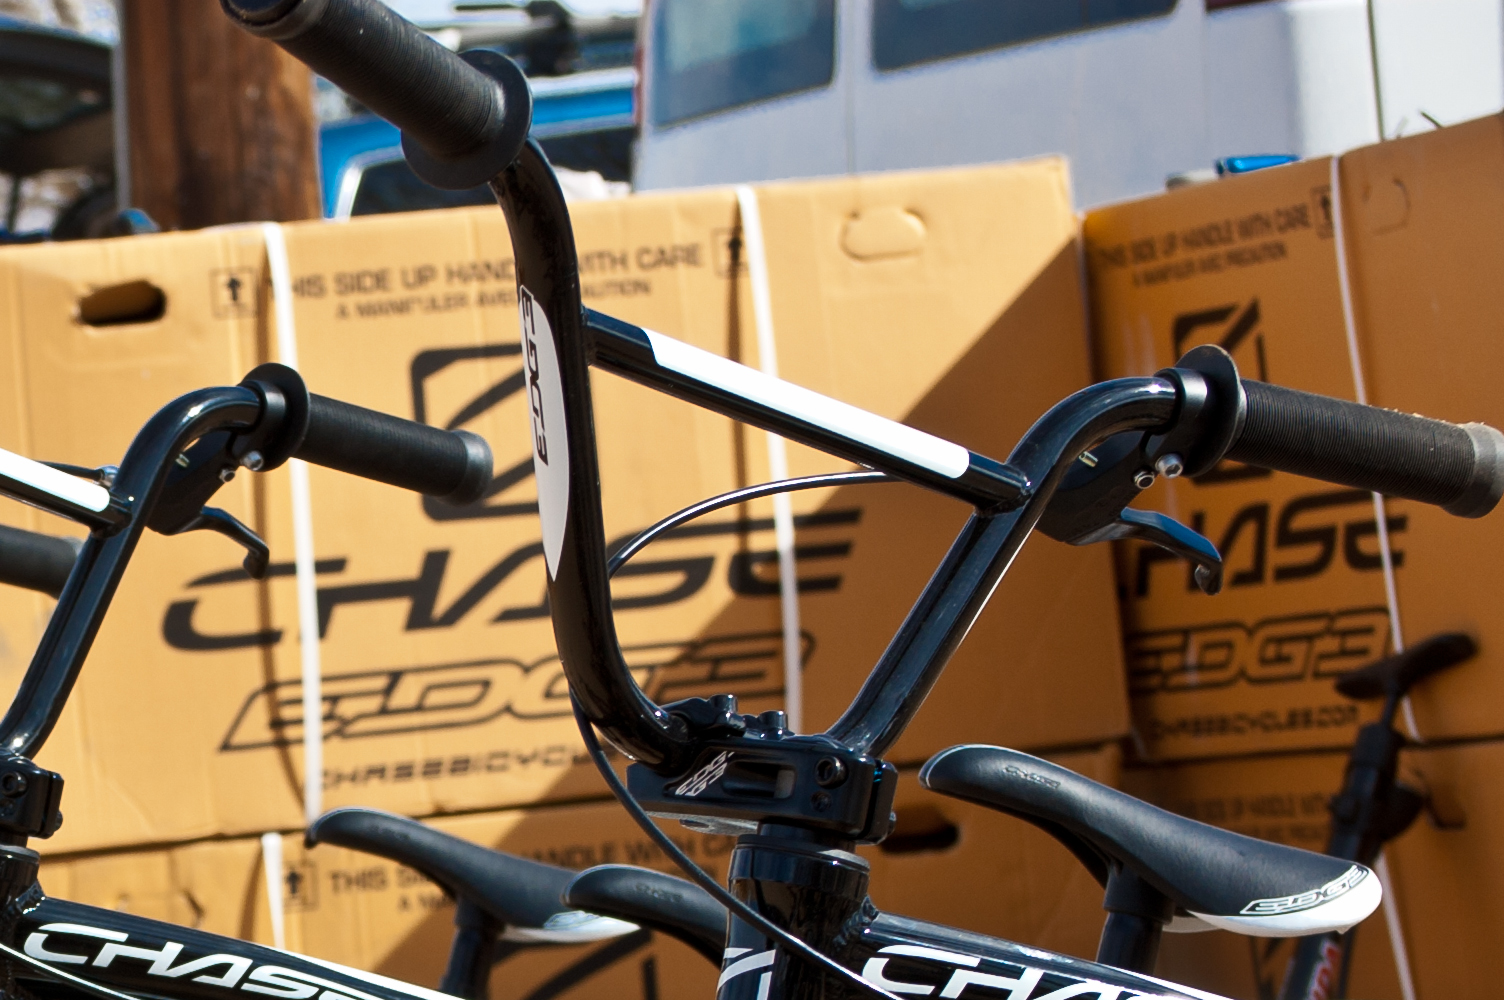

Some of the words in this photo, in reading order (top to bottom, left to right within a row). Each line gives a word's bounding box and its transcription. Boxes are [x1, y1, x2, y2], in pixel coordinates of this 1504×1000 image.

[292, 274, 327, 298] HIS
[333, 267, 393, 296] SIDE
[400, 263, 439, 290] UP
[636, 243, 704, 271] CARE
[162, 508, 864, 652] CHASE
[1135, 488, 1410, 598] HASE
